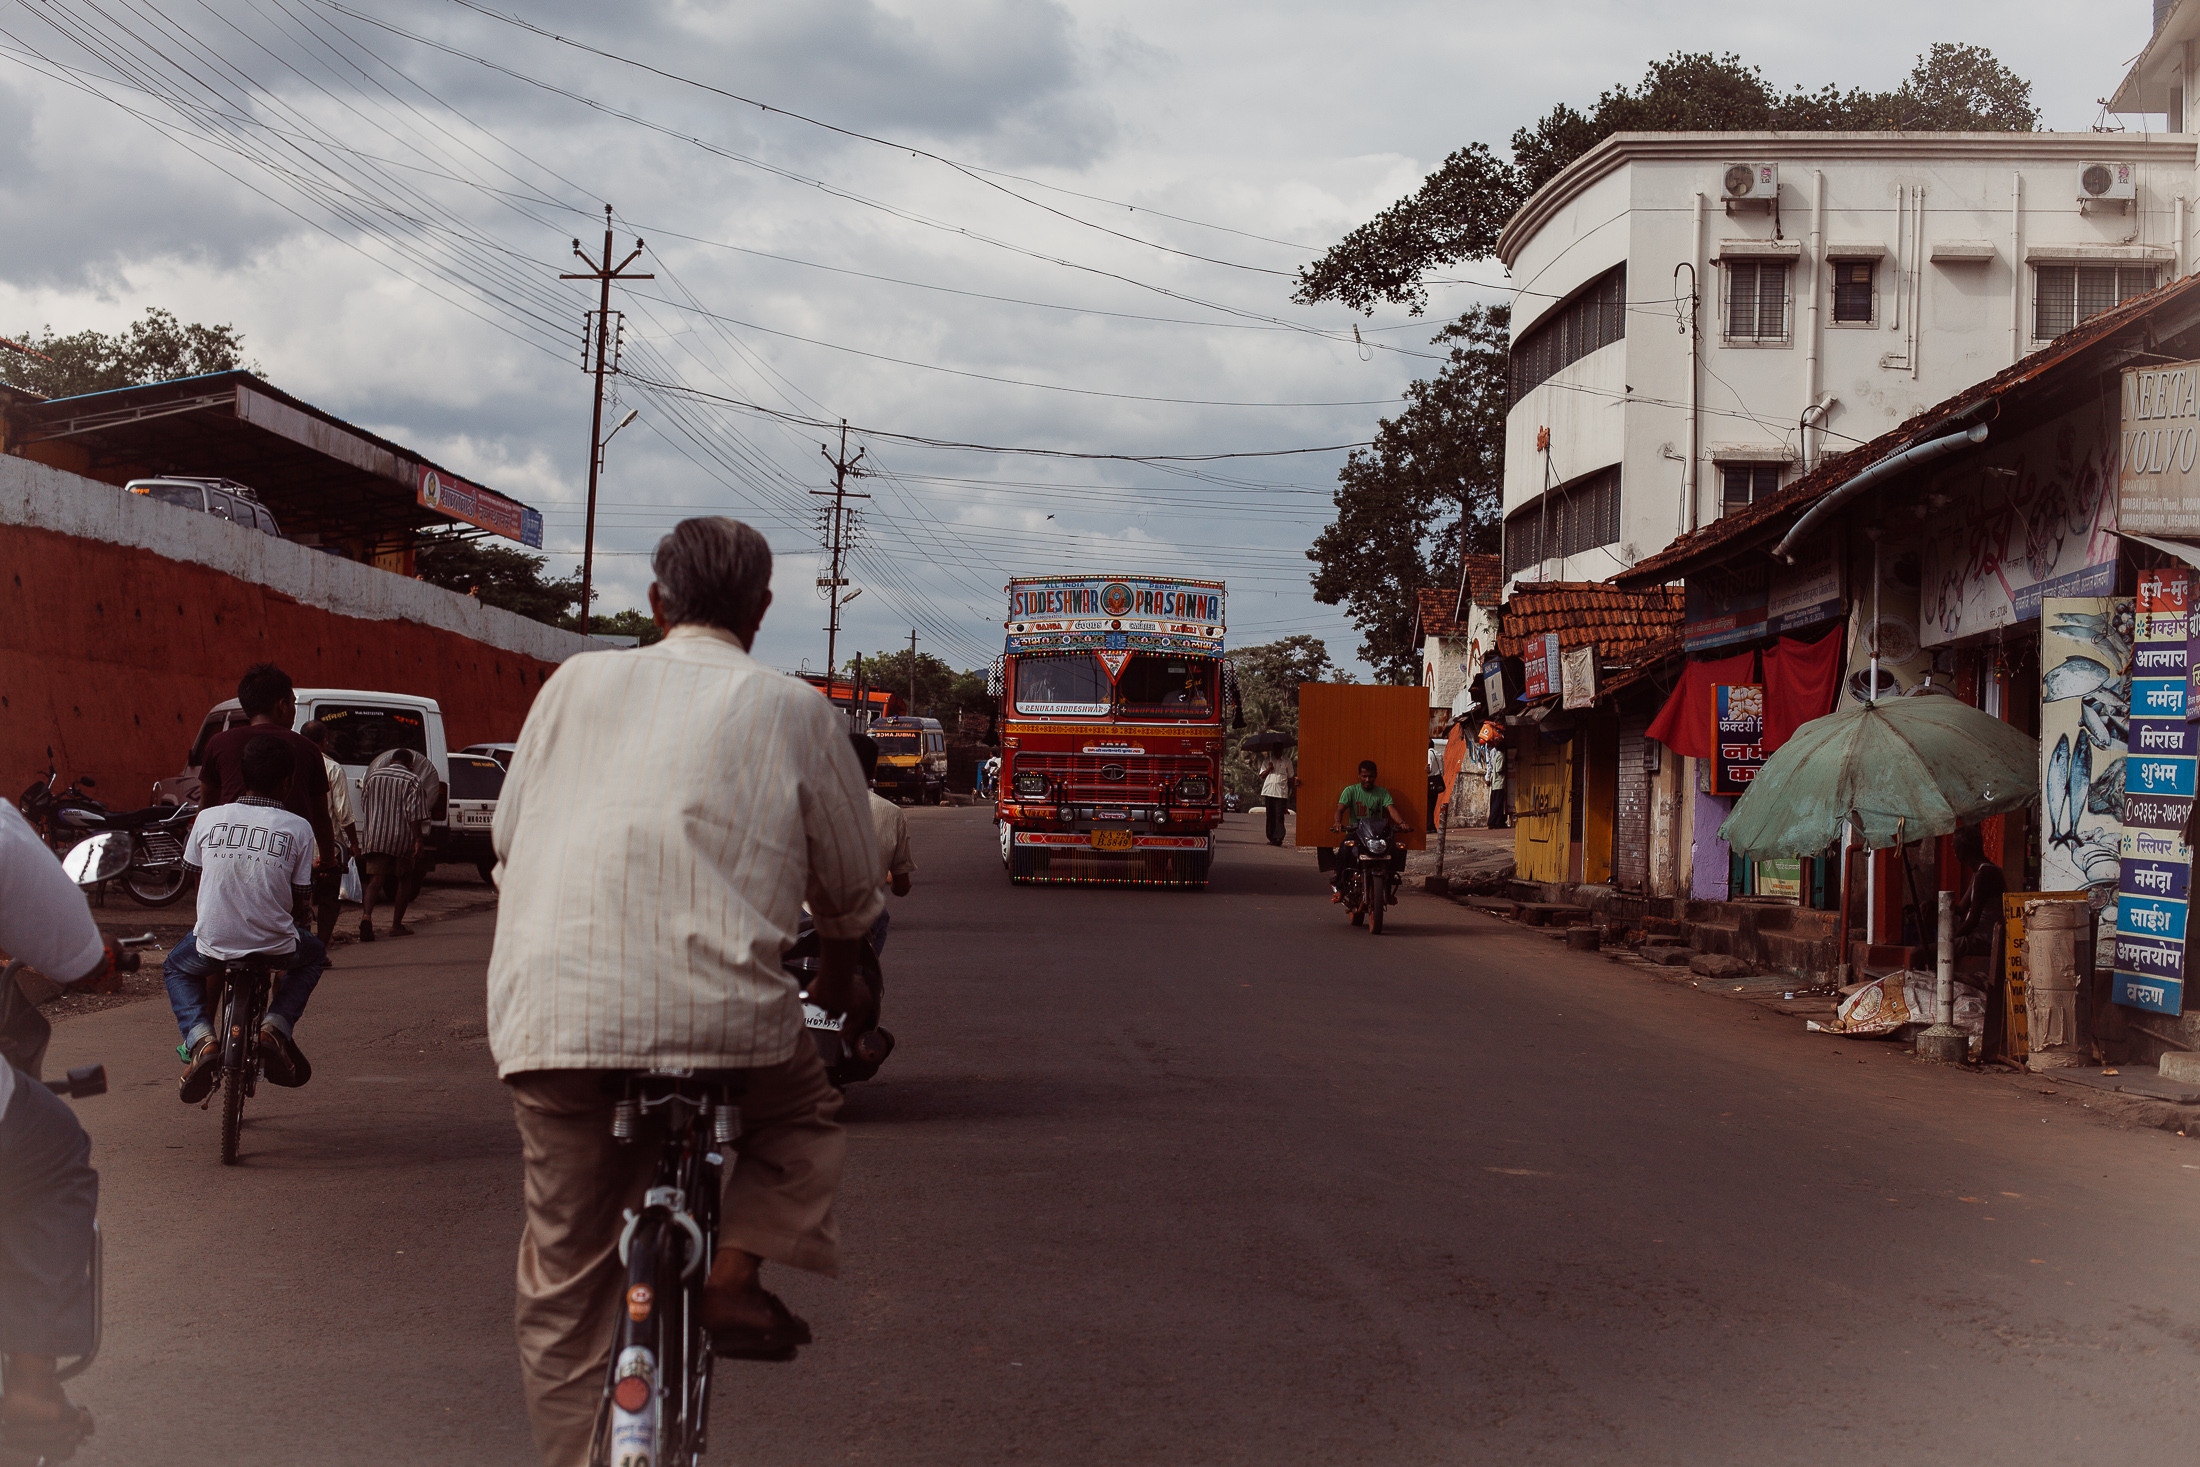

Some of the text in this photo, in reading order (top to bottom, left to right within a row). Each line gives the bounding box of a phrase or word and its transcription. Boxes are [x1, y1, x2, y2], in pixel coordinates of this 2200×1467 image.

[2121, 368, 2197, 422] NEETA
[2121, 426, 2197, 475] VOLVO
[1014, 589, 1219, 620] SIDDESHWAR PRASANNA
[1035, 623, 1062, 631] GANGA
[1075, 621, 1102, 629] GOODS
[1170, 624, 1196, 633] KAVERI
[1055, 705, 1103, 713] SIDDESHWAR
[2147, 684, 2183, 712] नर्मदा
[2140, 725, 2185, 749] मिरांडा
[2141, 763, 2177, 789] शुभम्
[1355, 801, 1367, 817] The
[208, 823, 293, 861] COOGI
[1050, 835, 1076, 843] PUNIT
[2137, 832, 2172, 855] स्लिपर
[214, 853, 283, 869] AUSTRALIA
[2134, 863, 2172, 894] नर्मदा
[2130, 904, 2171, 932] साईश
[2116, 941, 2181, 971] अमृतयोग
[2126, 983, 2164, 1006] वरुण
